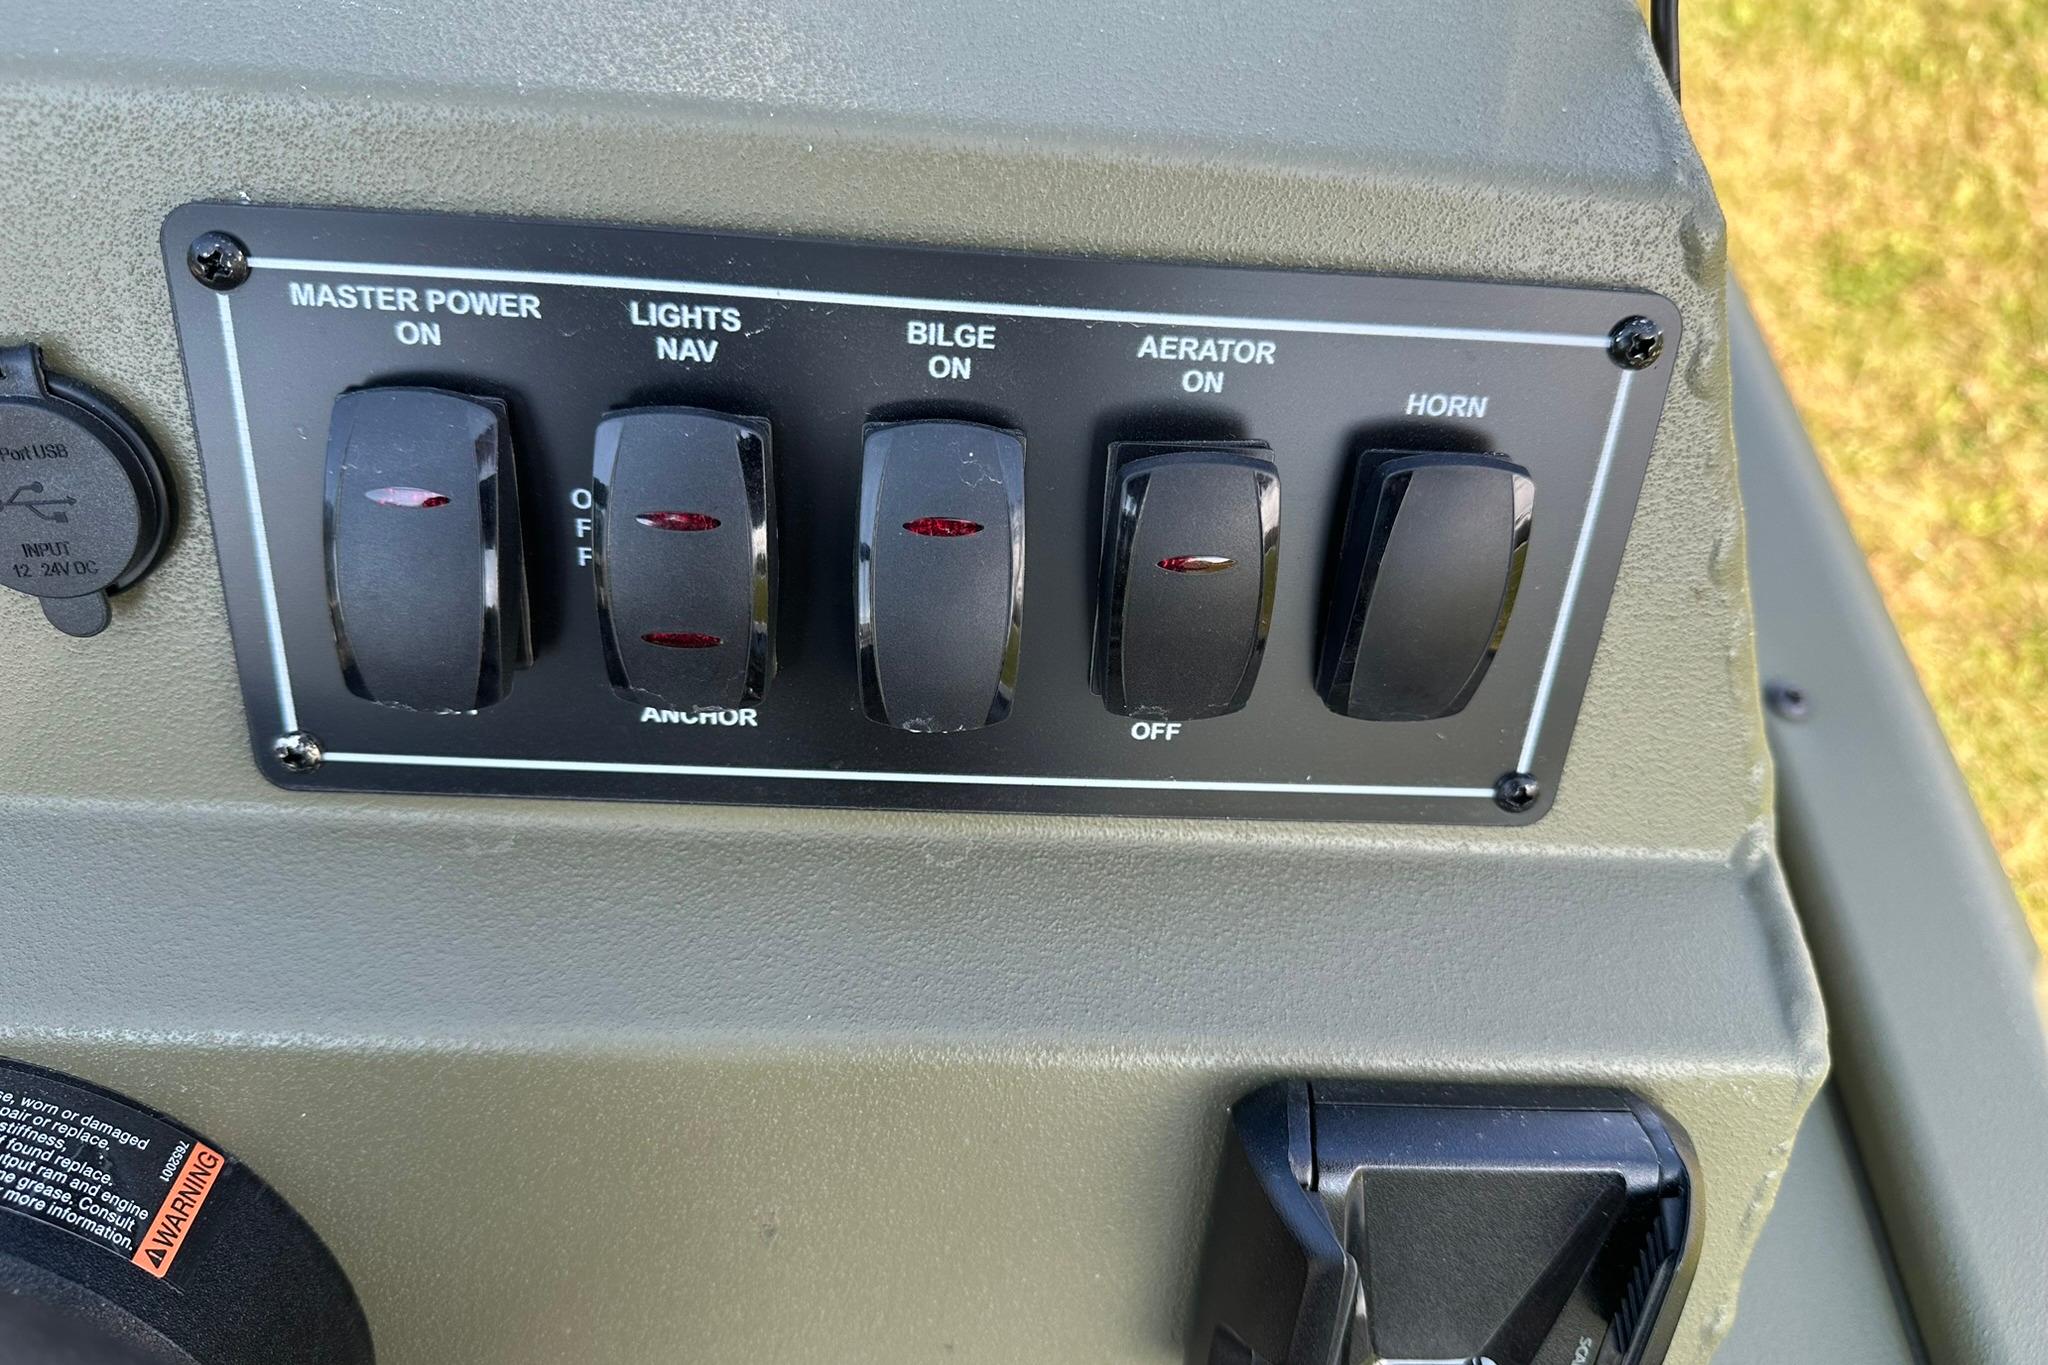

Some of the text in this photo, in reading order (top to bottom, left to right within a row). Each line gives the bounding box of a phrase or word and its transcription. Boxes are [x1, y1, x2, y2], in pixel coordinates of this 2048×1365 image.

[288, 281, 542, 319] MASTER POWER
[629, 301, 742, 333] LIGHTS
[394, 320, 442, 346] ON
[906, 319, 997, 350] BILGE
[655, 336, 719, 363] NAV
[1137, 335, 1277, 365] AERATOR
[928, 355, 972, 380] ON
[1182, 369, 1224, 394] ON
[1406, 393, 1489, 418] HORN
[0, 444, 69, 462] Port USB
[21, 541, 70, 558] INPUT
[41, 561, 70, 577] 24V
[74, 560, 99, 575] DC
[640, 706, 759, 727] ANCHOR
[1130, 721, 1182, 742] OFF
[0, 1121, 67, 1153] stiffness,
[21, 1097, 59, 1116] worn
[61, 1109, 80, 1121] or
[80, 1115, 151, 1151] damaged
[33, 1116, 52, 1128] or
[51, 1121, 110, 1151] replace.
[6, 1138, 55, 1162] found
[54, 1155, 113, 1186] replace.
[159, 1140, 190, 1183] 7652001
[16, 1177, 73, 1205] grease.
[78, 1196, 136, 1232] Consult
[36, 1165, 68, 1184] ram
[69, 1178, 102, 1197] and
[101, 1191, 149, 1220] engine
[151, 1151, 220, 1248] WARNING
[3, 1189, 133, 1251] more information.
[1570, 1335, 1593, 1365] SCA
